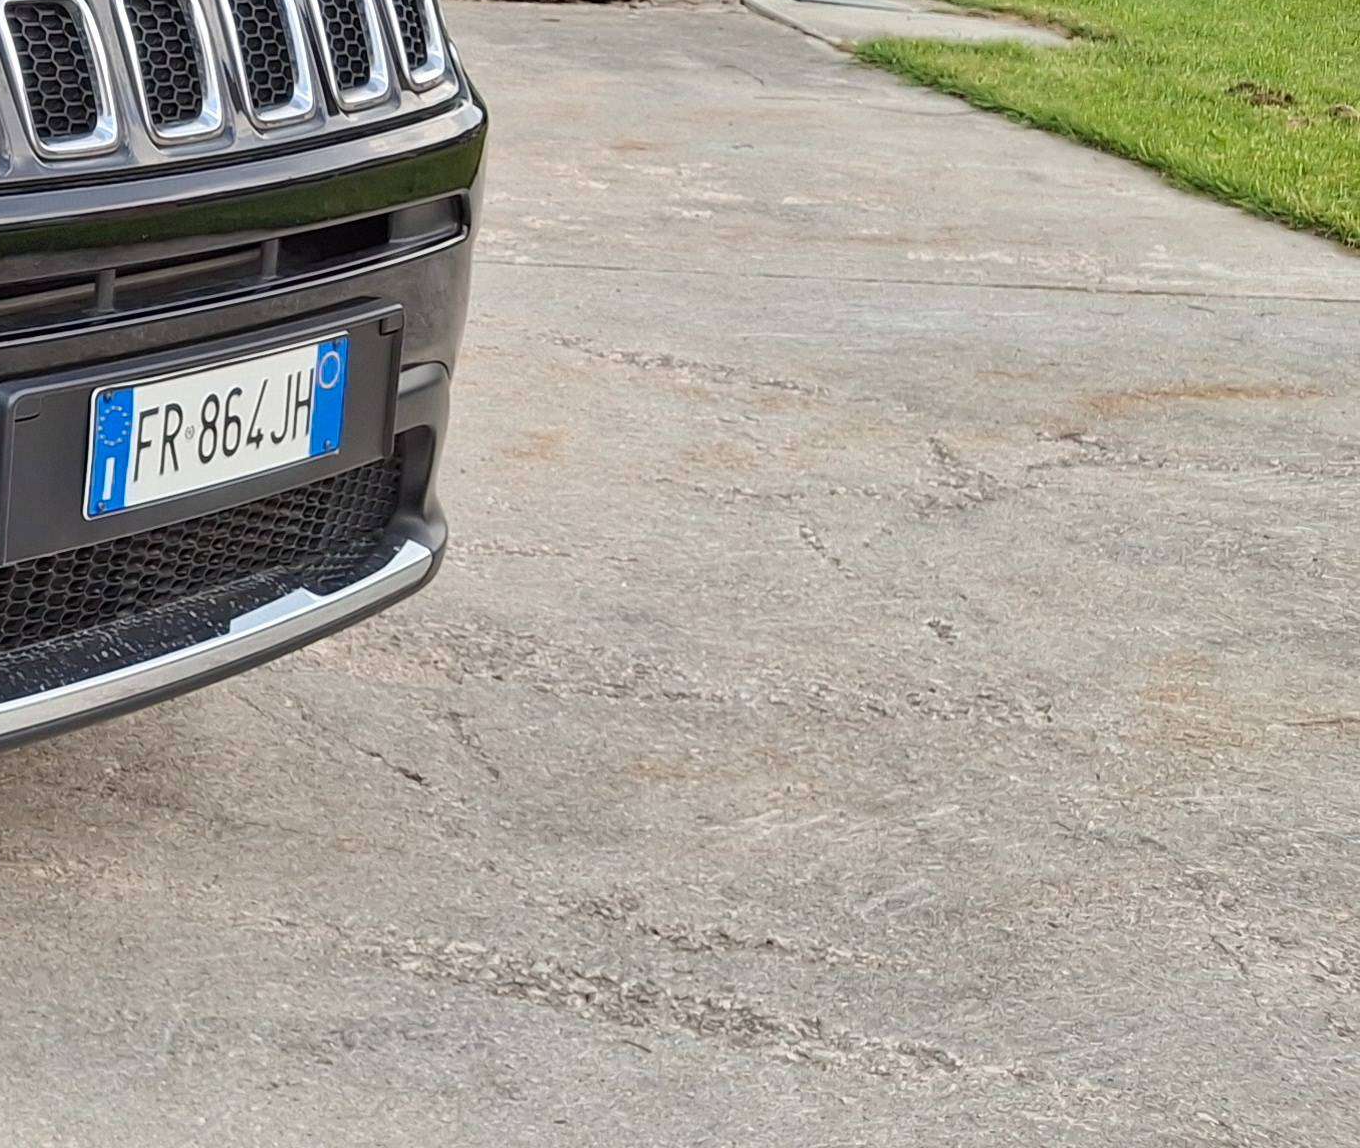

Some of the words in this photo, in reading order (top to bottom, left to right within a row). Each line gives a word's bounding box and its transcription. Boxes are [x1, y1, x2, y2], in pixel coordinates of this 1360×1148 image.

[133, 402, 184, 483] FR
[197, 366, 315, 465] 864JH
[102, 456, 116, 501] I
